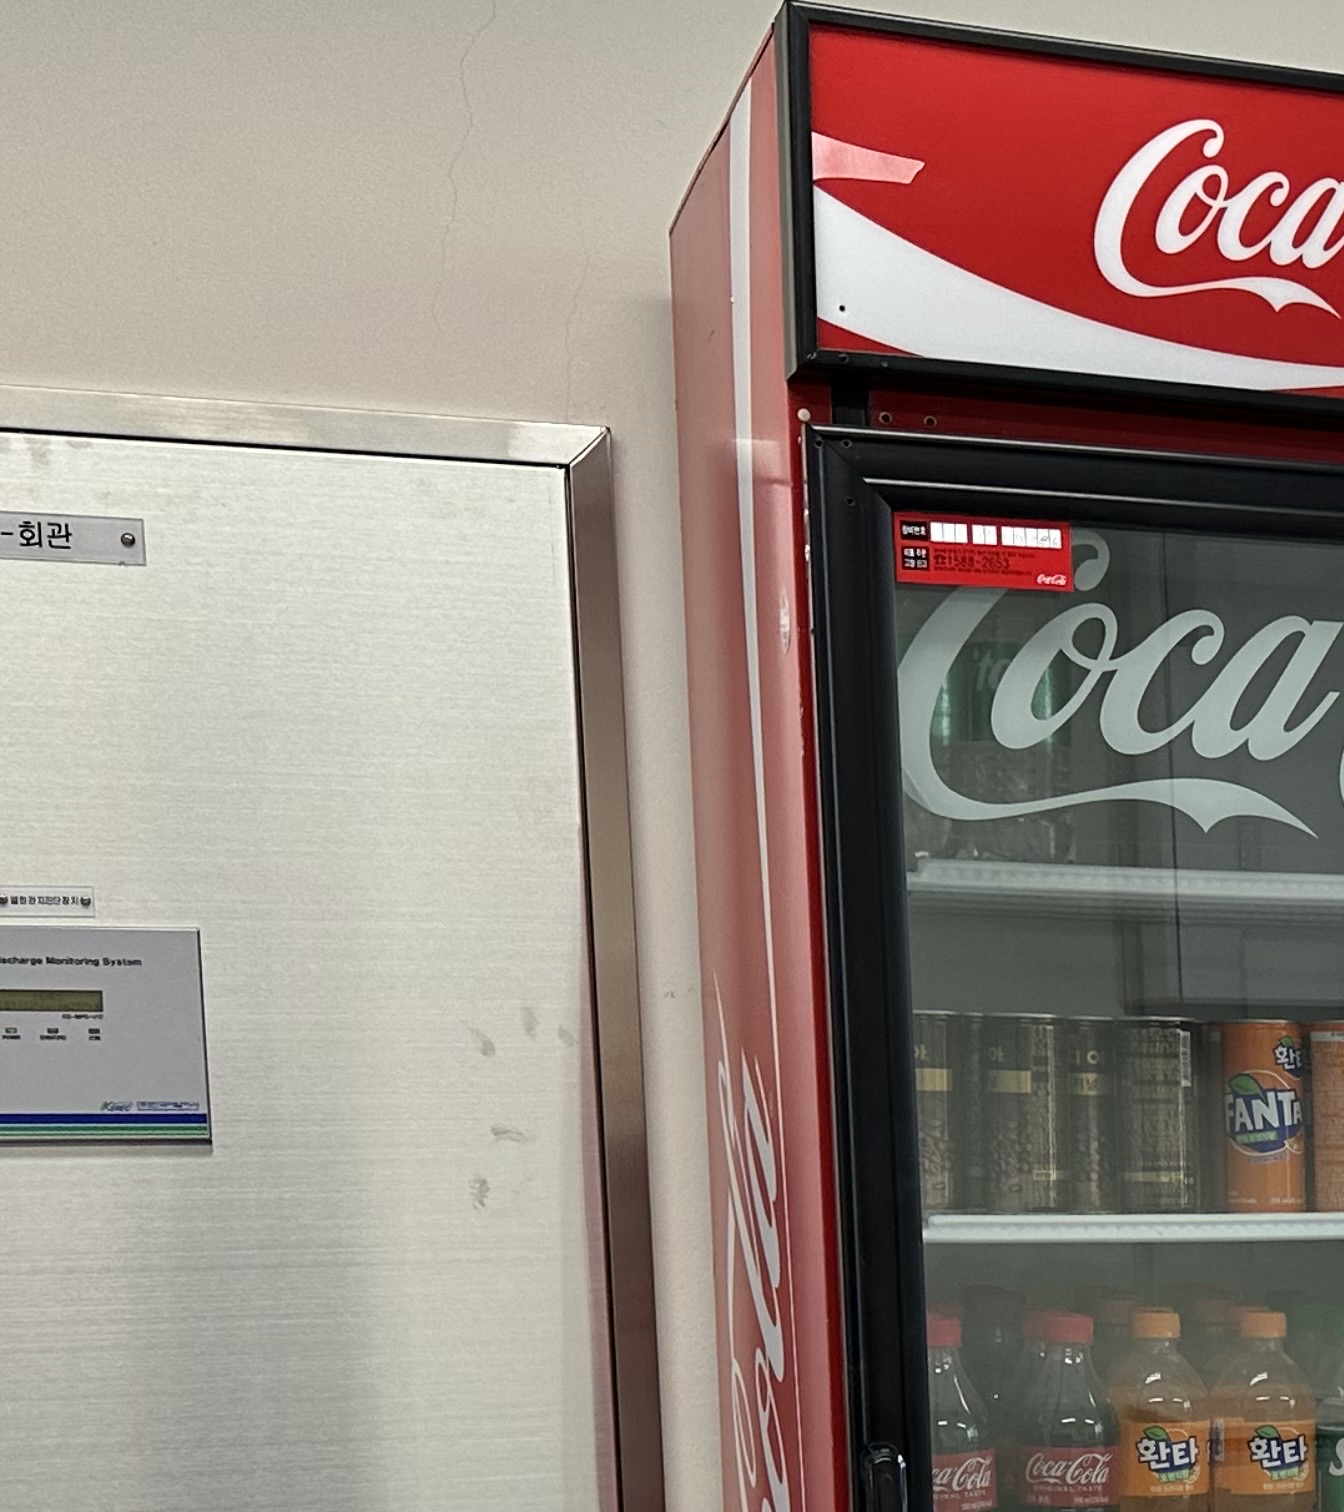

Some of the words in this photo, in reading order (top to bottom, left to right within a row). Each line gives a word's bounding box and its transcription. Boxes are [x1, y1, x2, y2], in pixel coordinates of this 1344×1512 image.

[1137, 1437, 1200, 1469] 환타
[1249, 1435, 1307, 1468] 환타
[1025, 1452, 1113, 1485] Coca-Cola
